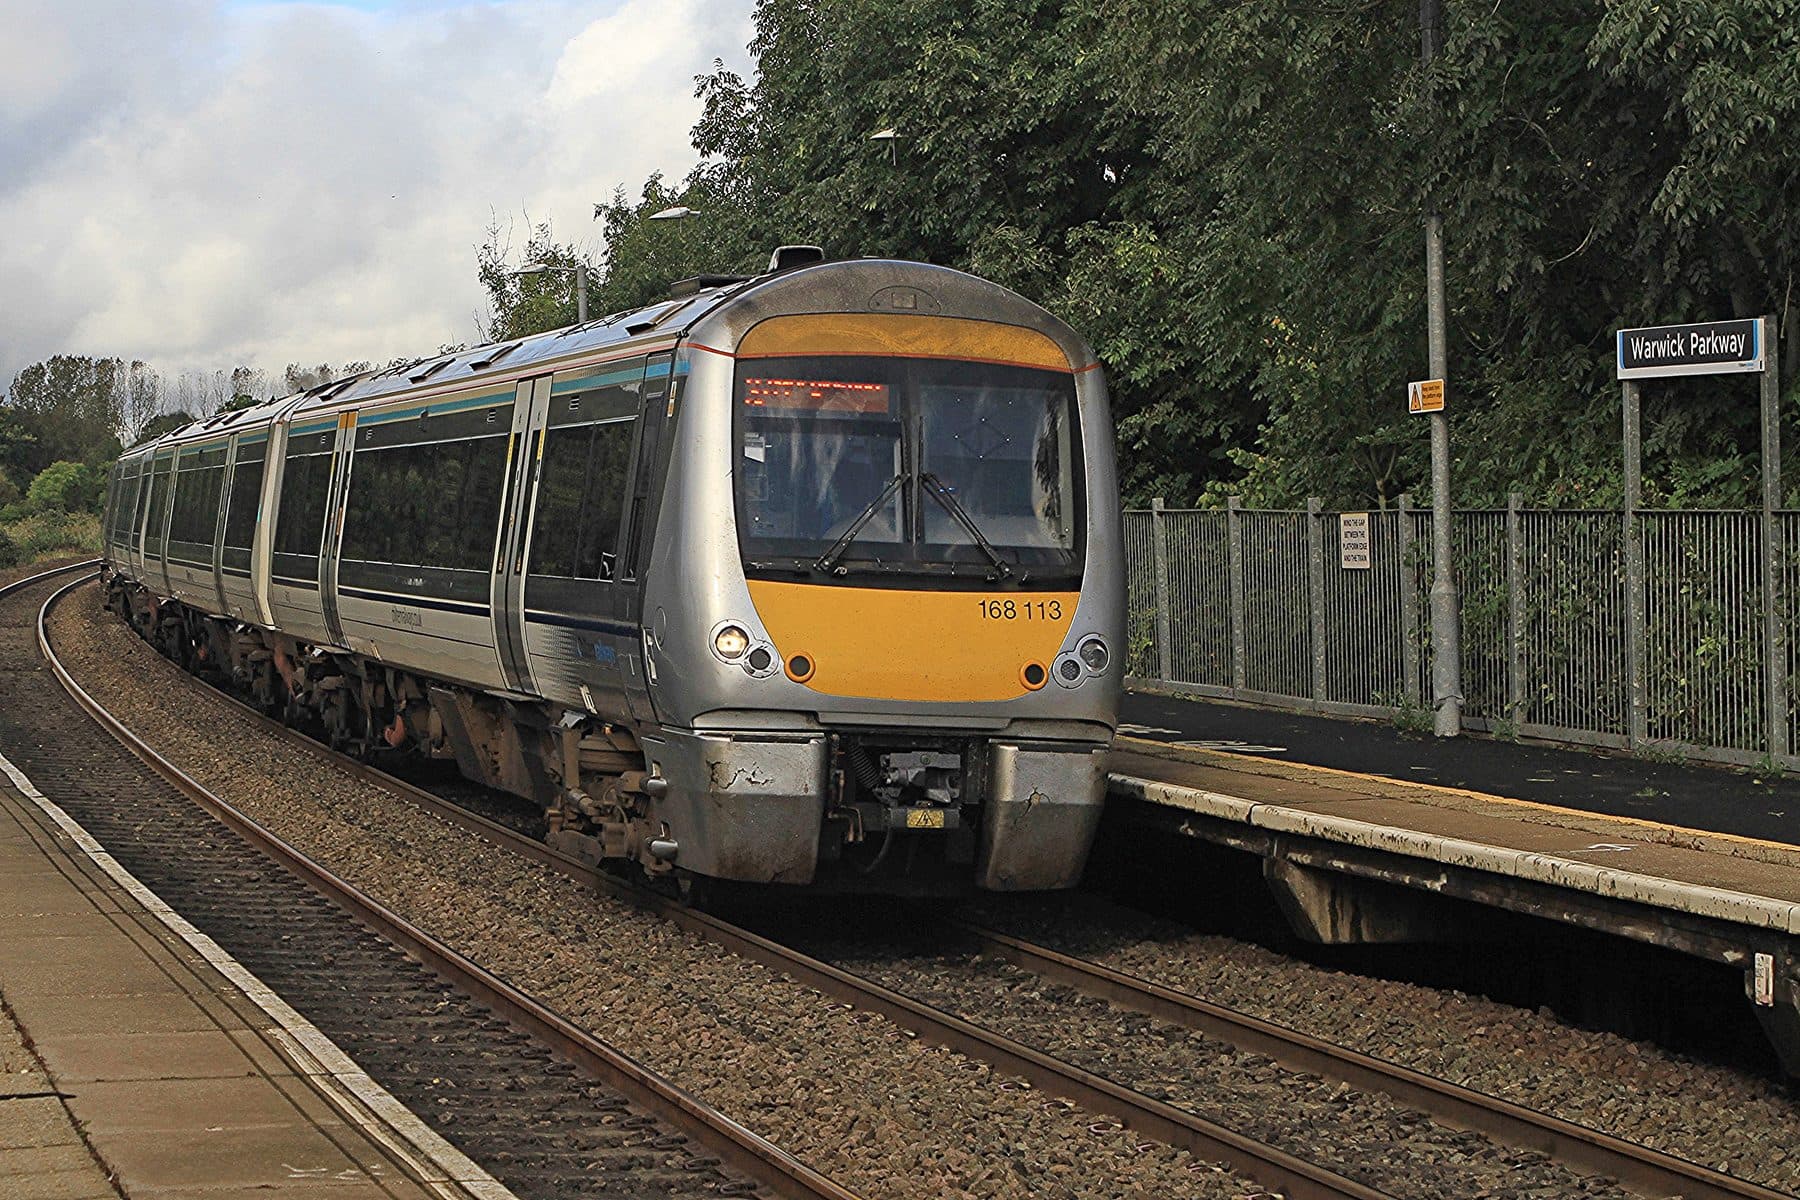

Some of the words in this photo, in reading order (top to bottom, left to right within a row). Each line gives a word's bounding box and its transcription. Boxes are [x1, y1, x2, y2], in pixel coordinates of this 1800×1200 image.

[1630, 331, 1685, 360] Warwick
[1690, 330, 1746, 357] Parkway
[978, 599, 1017, 620] 168
[1023, 600, 1062, 620] 113
